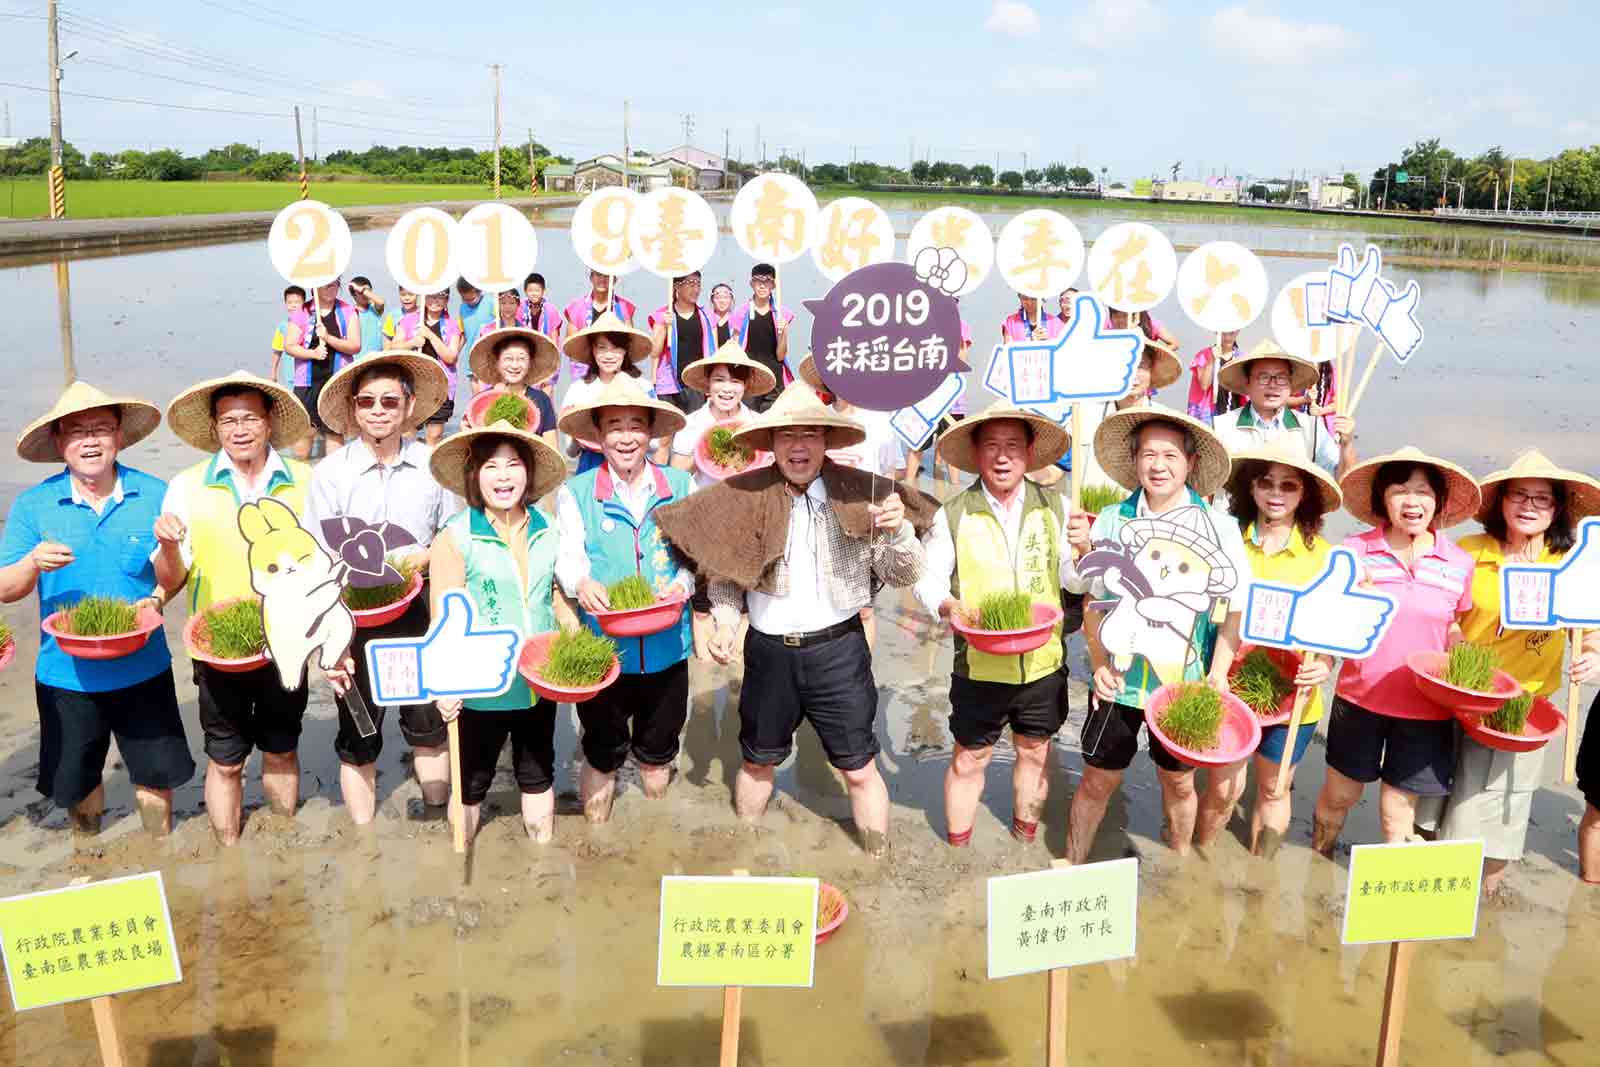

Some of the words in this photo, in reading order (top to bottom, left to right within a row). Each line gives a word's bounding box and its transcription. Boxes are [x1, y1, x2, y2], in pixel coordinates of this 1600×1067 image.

[842, 289, 930, 327] 2019
[825, 333, 948, 375] 來稻台南
[1359, 875, 1472, 896] 臺南市政府農業局
[1021, 895, 1109, 922] 臺南市政府
[15, 915, 158, 953] 行政院農業委員會
[672, 917, 805, 935] 行政院農業委員會
[1016, 925, 1068, 948] 黃偉哲
[1080, 919, 1113, 938] 市長
[22, 939, 163, 980] 臺南區農業改良場
